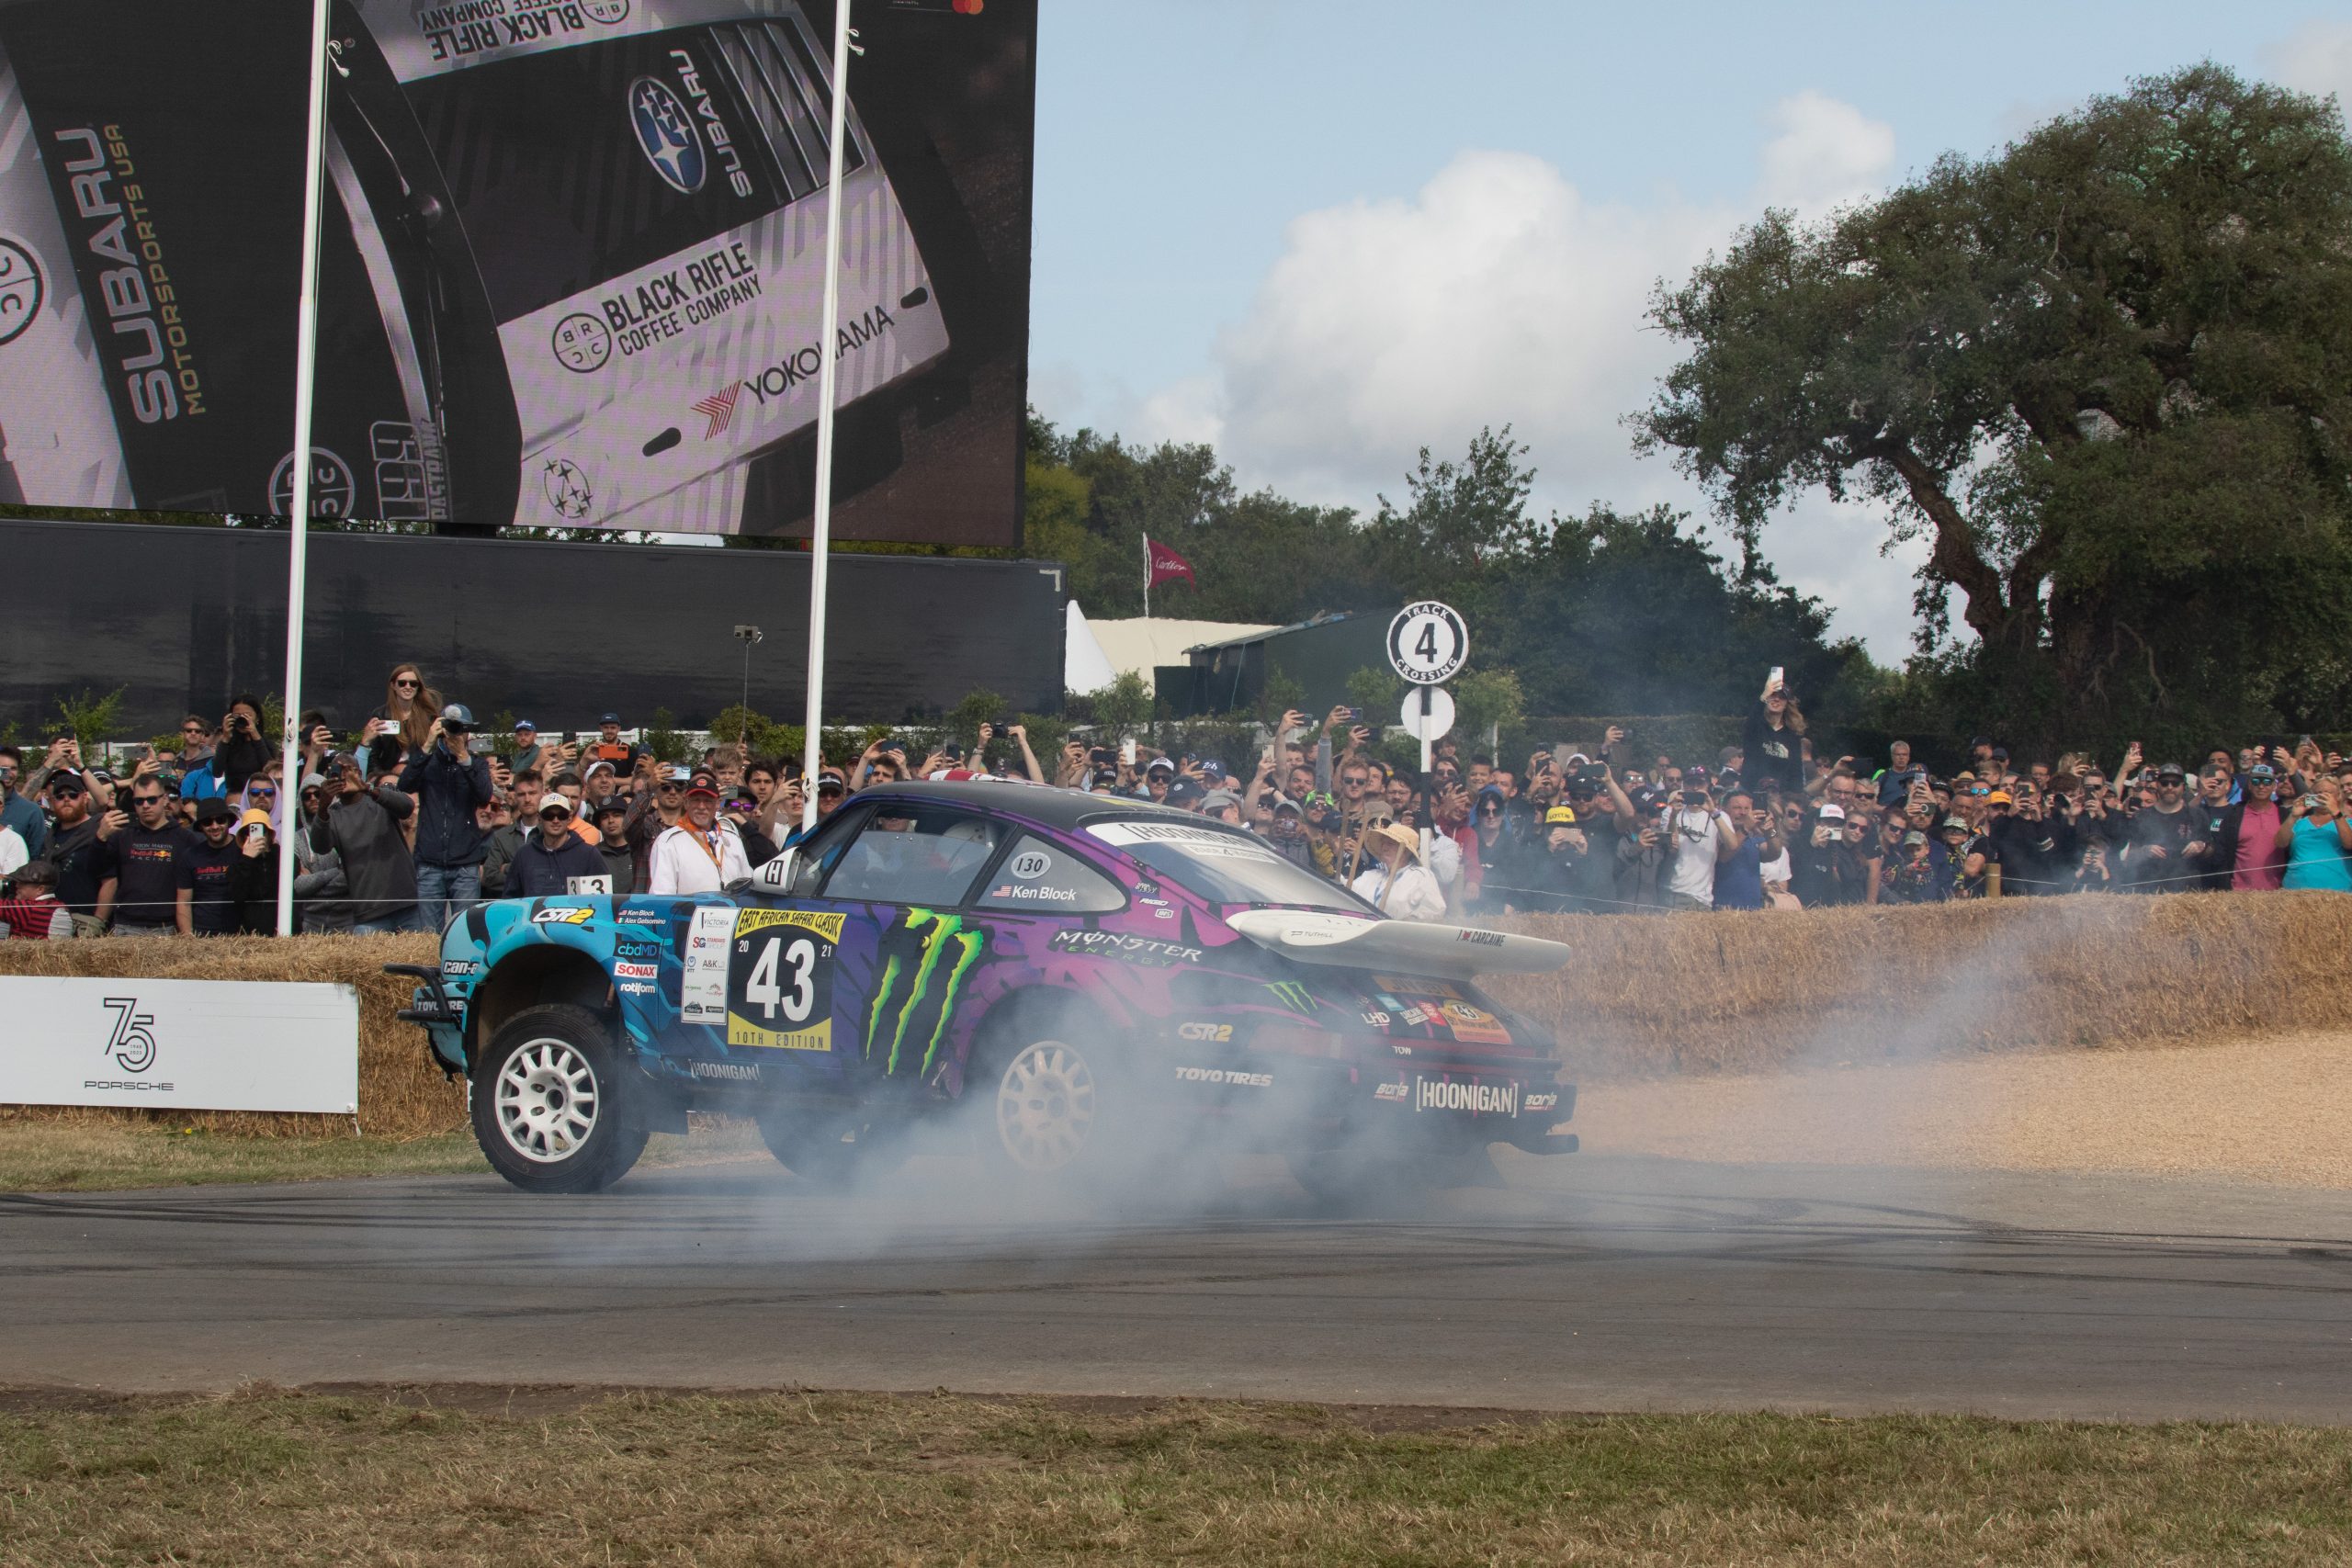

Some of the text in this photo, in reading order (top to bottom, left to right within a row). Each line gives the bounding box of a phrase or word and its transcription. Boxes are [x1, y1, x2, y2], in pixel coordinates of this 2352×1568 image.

[424, 4, 585, 61] BLACK RIFLE
[670, 50, 753, 197] SUBARU
[56, 128, 177, 424] SUBARU
[104, 125, 206, 415] MOTORSPORTS USA
[601, 242, 753, 332] BLACK RIFLE
[617, 273, 763, 356] COFFEE COMPANY
[1156, 556, 1186, 570] Cartier
[1405, 604, 1450, 619] TRACK
[1415, 622, 1437, 663] 4
[1396, 658, 1457, 680] CROSSING
[1017, 858, 1043, 872] 130
[1012, 886, 1077, 900] Ken Block
[739, 910, 843, 937] EAST AFRICAN SAFARI CLASSIC
[617, 943, 657, 956] cbdMD
[739, 941, 831, 957] 20 21
[1068, 945, 1172, 966] ENERGY
[617, 964, 655, 976] SONAX
[746, 937, 815, 1022] 43
[1361, 1011, 1390, 1023] LHD
[104, 998, 155, 1073] 75
[736, 1032, 824, 1049] 10TH EDITION
[1178, 1022, 1233, 1042] CSR2
[1392, 1046, 1411, 1055] TOW
[85, 1081, 175, 1090] PORSCHE
[1176, 1066, 1272, 1087] TOYO TIRES
